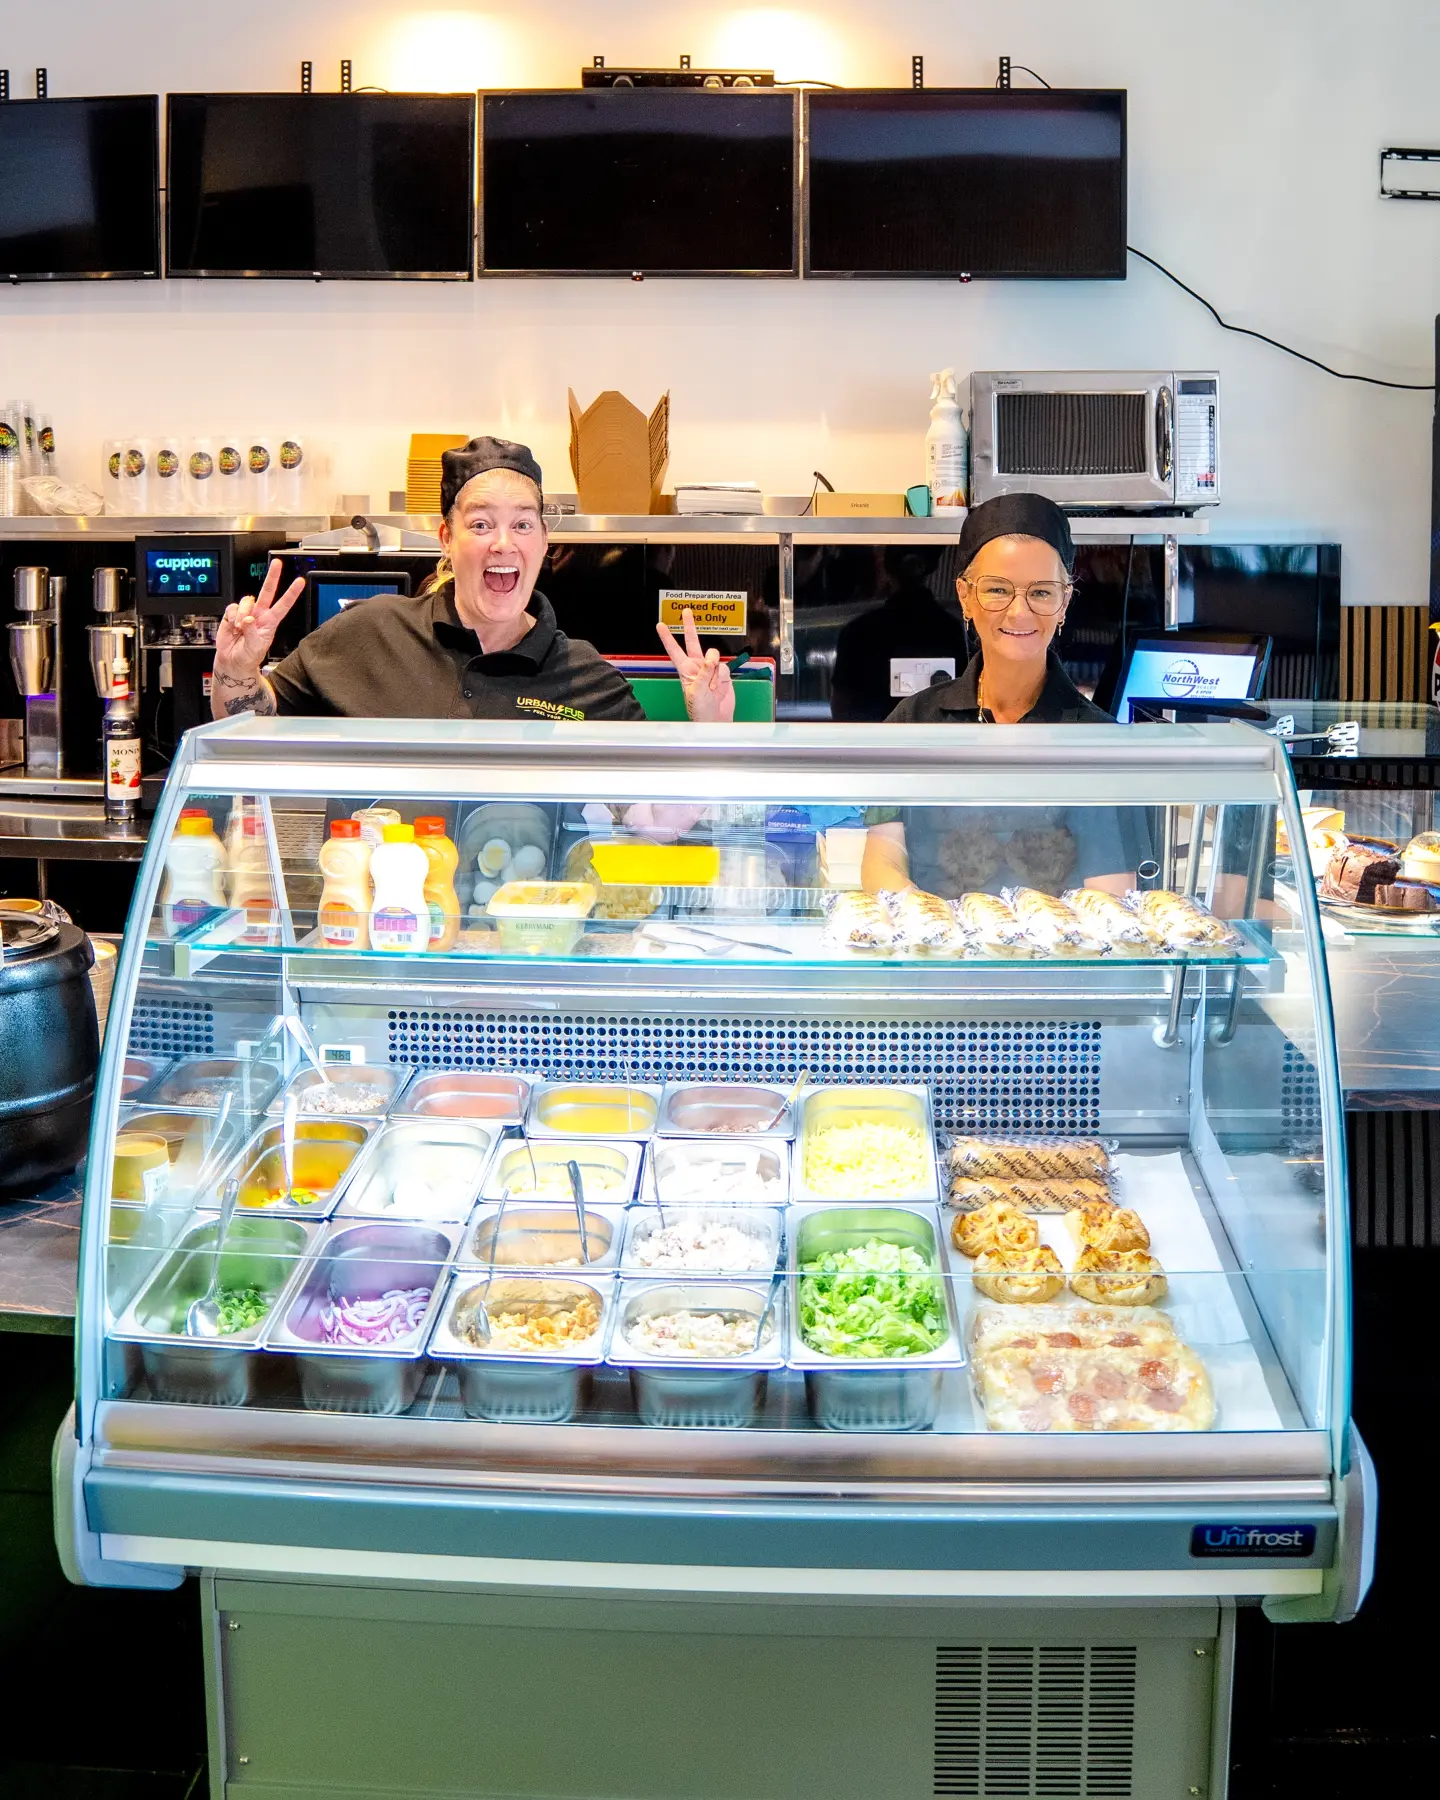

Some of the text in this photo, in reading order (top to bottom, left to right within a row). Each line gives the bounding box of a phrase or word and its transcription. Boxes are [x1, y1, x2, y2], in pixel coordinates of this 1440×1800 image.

[156, 558, 212, 571] cuppion
[671, 602, 736, 611] Cooked Food
[679, 614, 727, 624] Aea Only
[1162, 674, 1220, 685] NorthWest
[516, 696, 556, 712] URBAN
[1205, 1526, 1304, 1546] Unifrost
